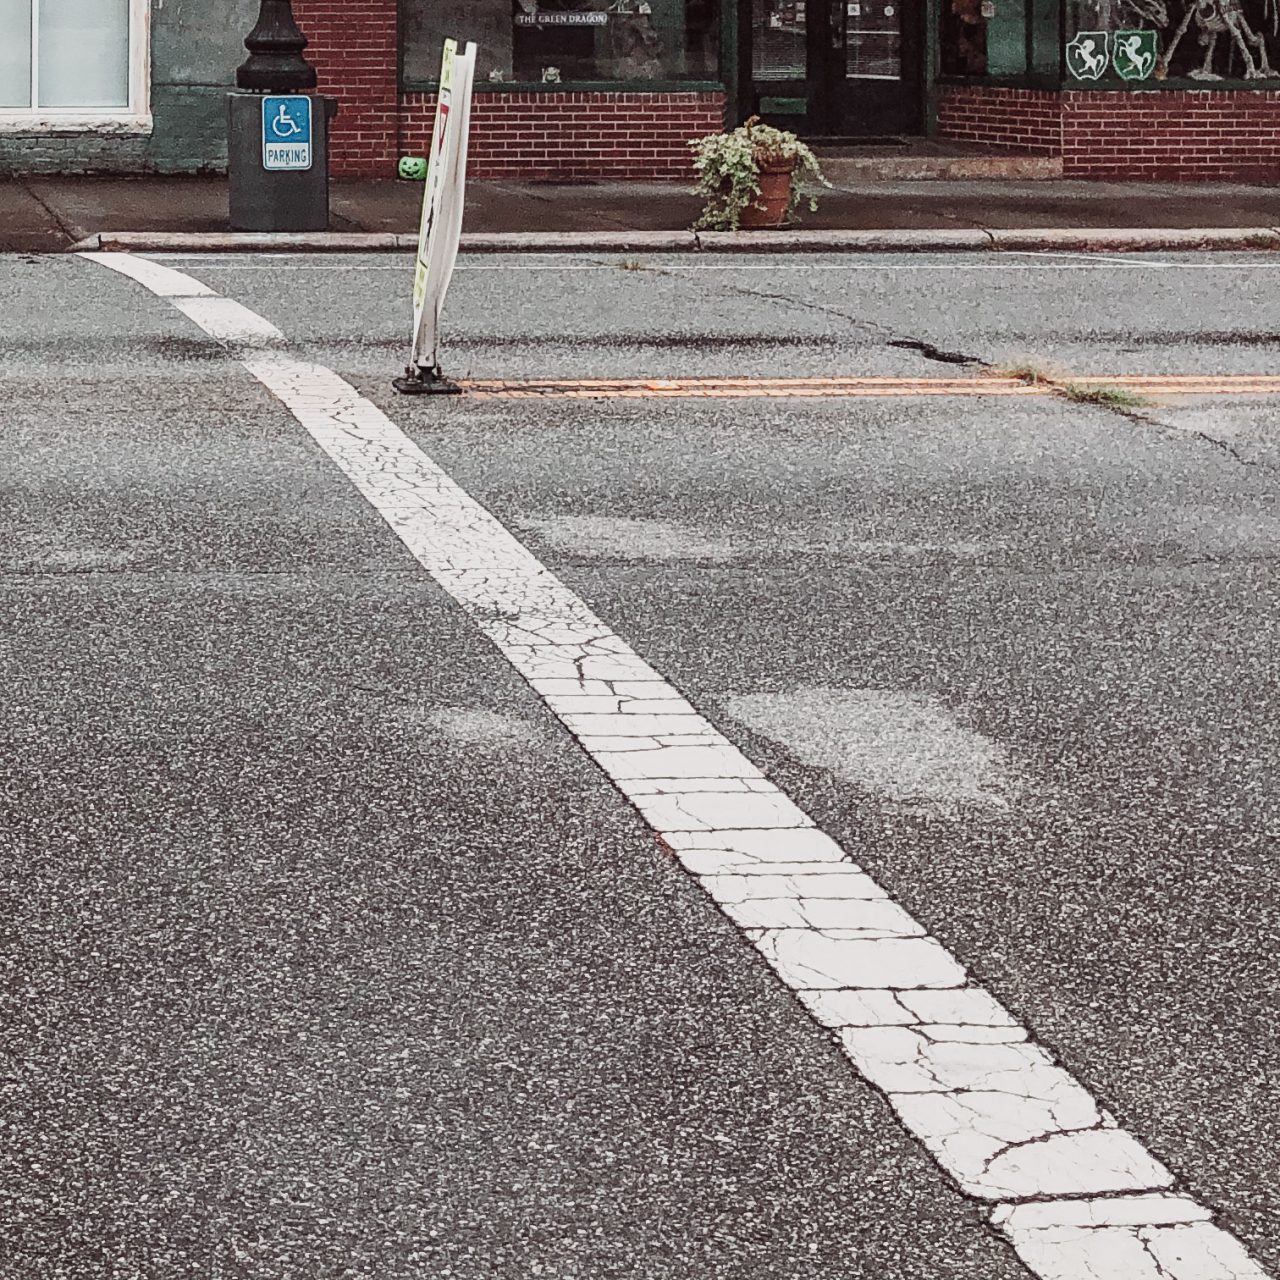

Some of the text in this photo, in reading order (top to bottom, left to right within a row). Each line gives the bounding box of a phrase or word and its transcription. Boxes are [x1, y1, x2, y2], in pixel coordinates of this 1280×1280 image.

[519, 13, 605, 24] THE GREEN DRAGON
[268, 148, 307, 163] PARKING
